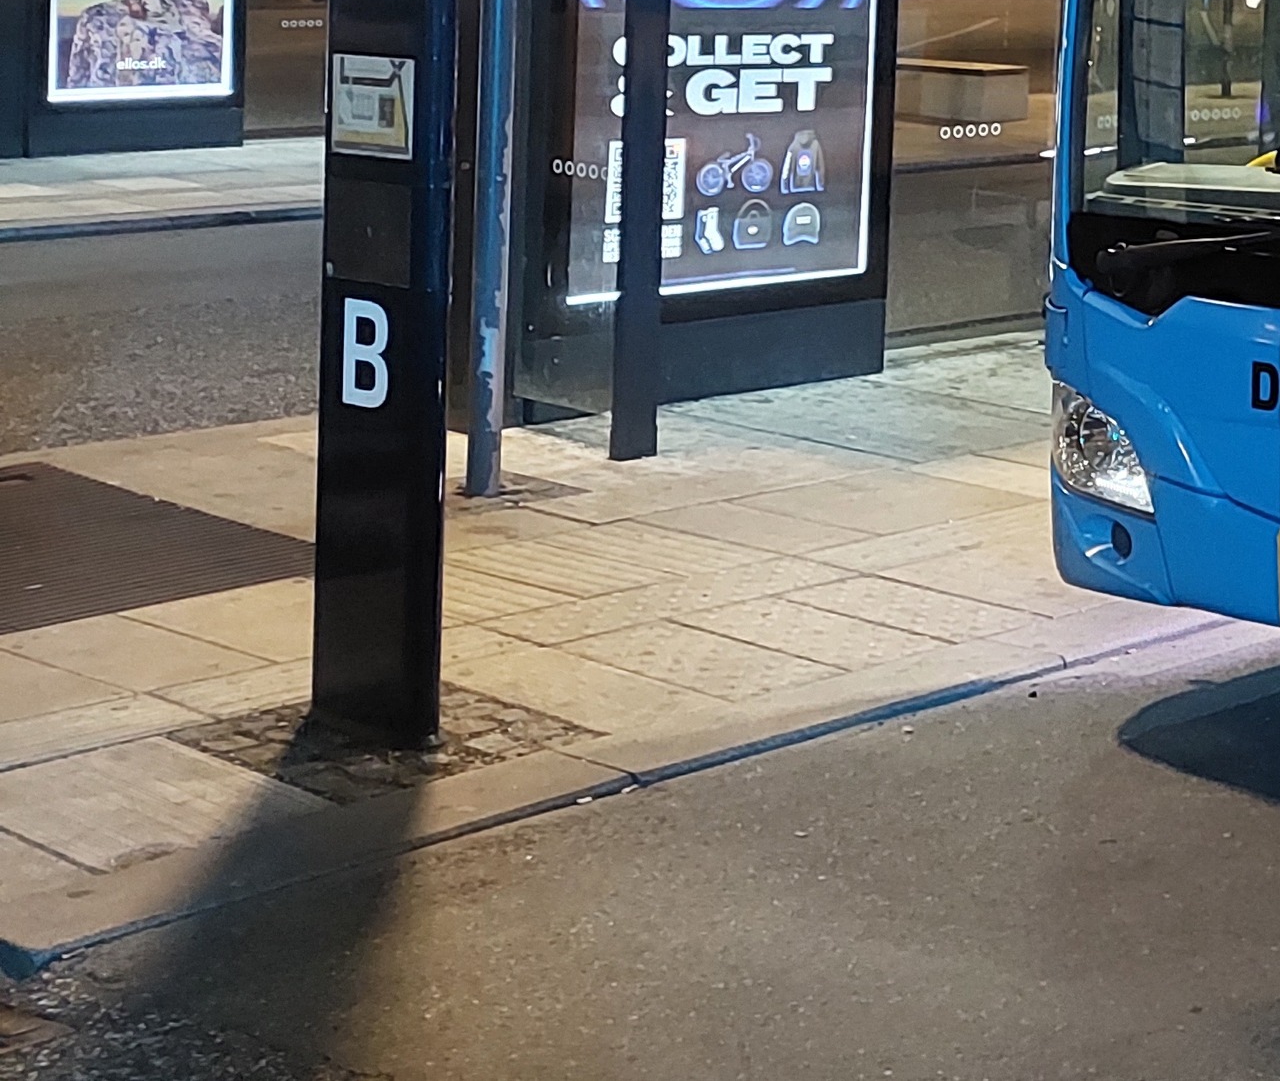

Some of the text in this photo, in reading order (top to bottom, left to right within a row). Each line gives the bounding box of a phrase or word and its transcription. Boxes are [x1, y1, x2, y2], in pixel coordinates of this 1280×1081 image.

[116, 57, 167, 70] ellos.dk
[685, 66, 833, 116] GET
[343, 297, 389, 409] B
